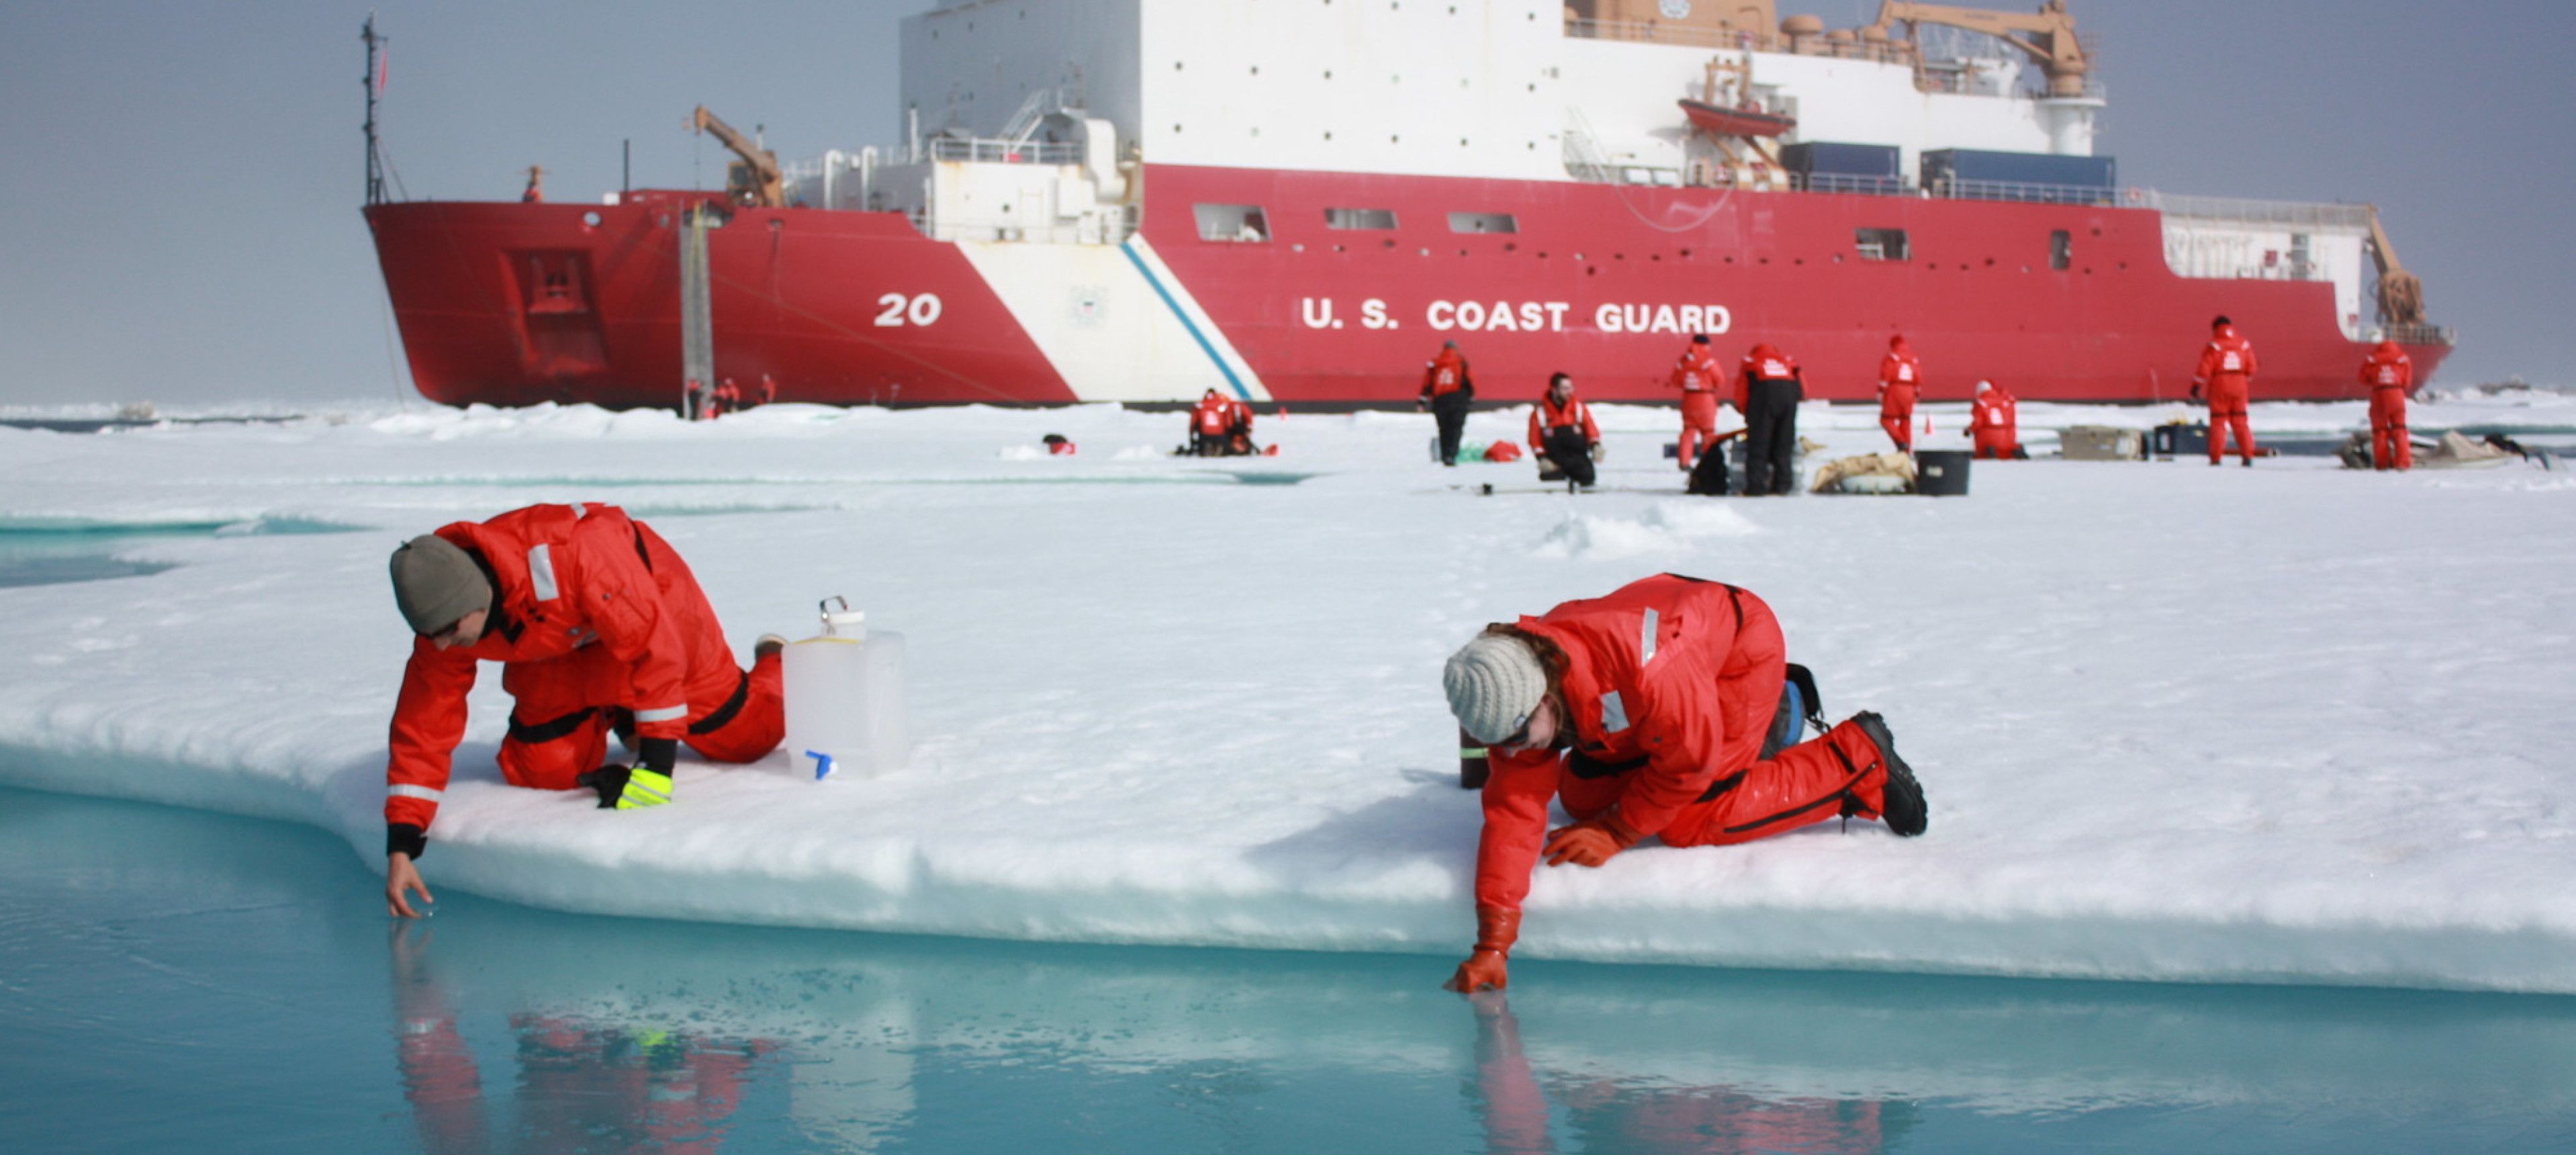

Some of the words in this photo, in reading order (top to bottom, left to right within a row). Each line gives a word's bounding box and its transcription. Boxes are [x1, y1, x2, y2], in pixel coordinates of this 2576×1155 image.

[874, 292, 941, 327] 20
[1426, 300, 1570, 331] COAST
[1595, 303, 1731, 334] GUARD
